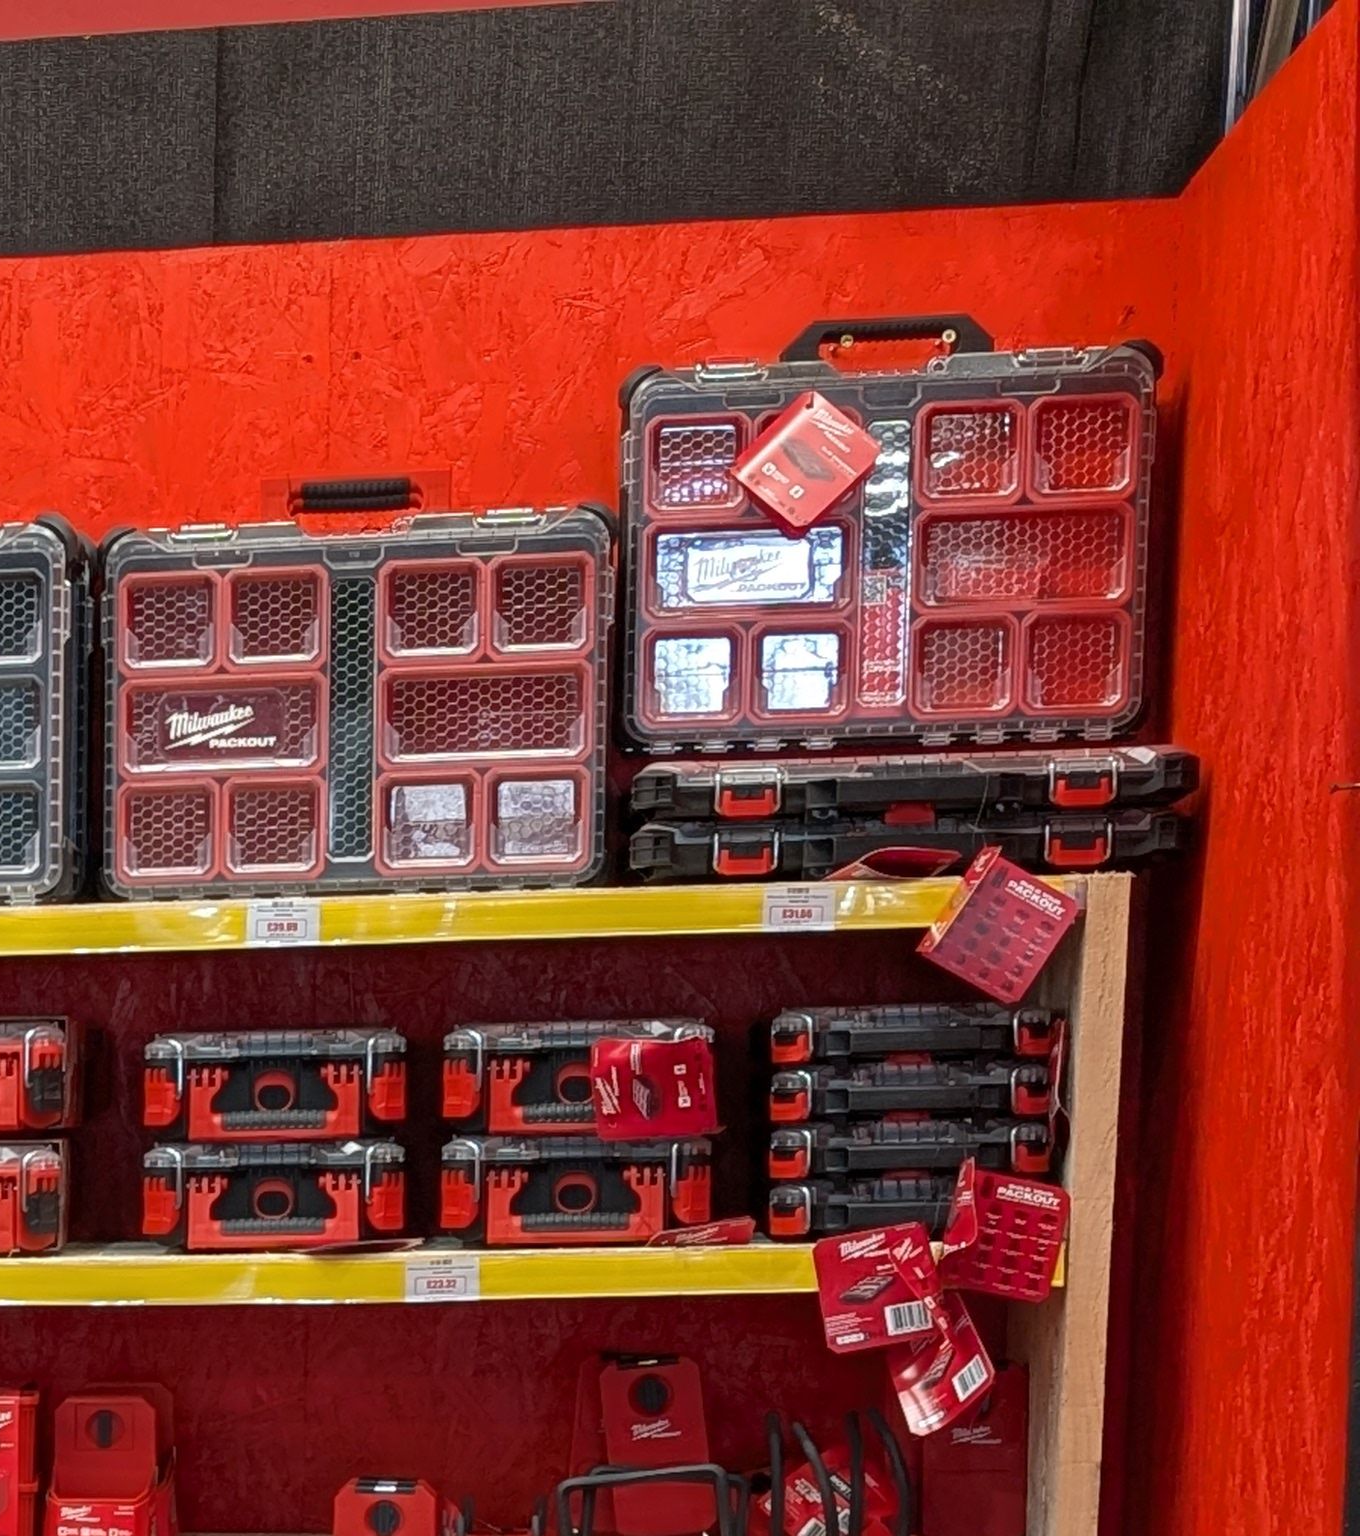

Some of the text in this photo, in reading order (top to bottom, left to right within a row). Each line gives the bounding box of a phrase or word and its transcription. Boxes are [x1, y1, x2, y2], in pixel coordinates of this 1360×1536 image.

[697, 549, 780, 582] Milwaukee
[165, 704, 254, 739] Milwaukee
[208, 737, 277, 749] PACKOUT
[1007, 880, 1066, 917] PACKOUT
[997, 1186, 1062, 1207] PACKOUT
